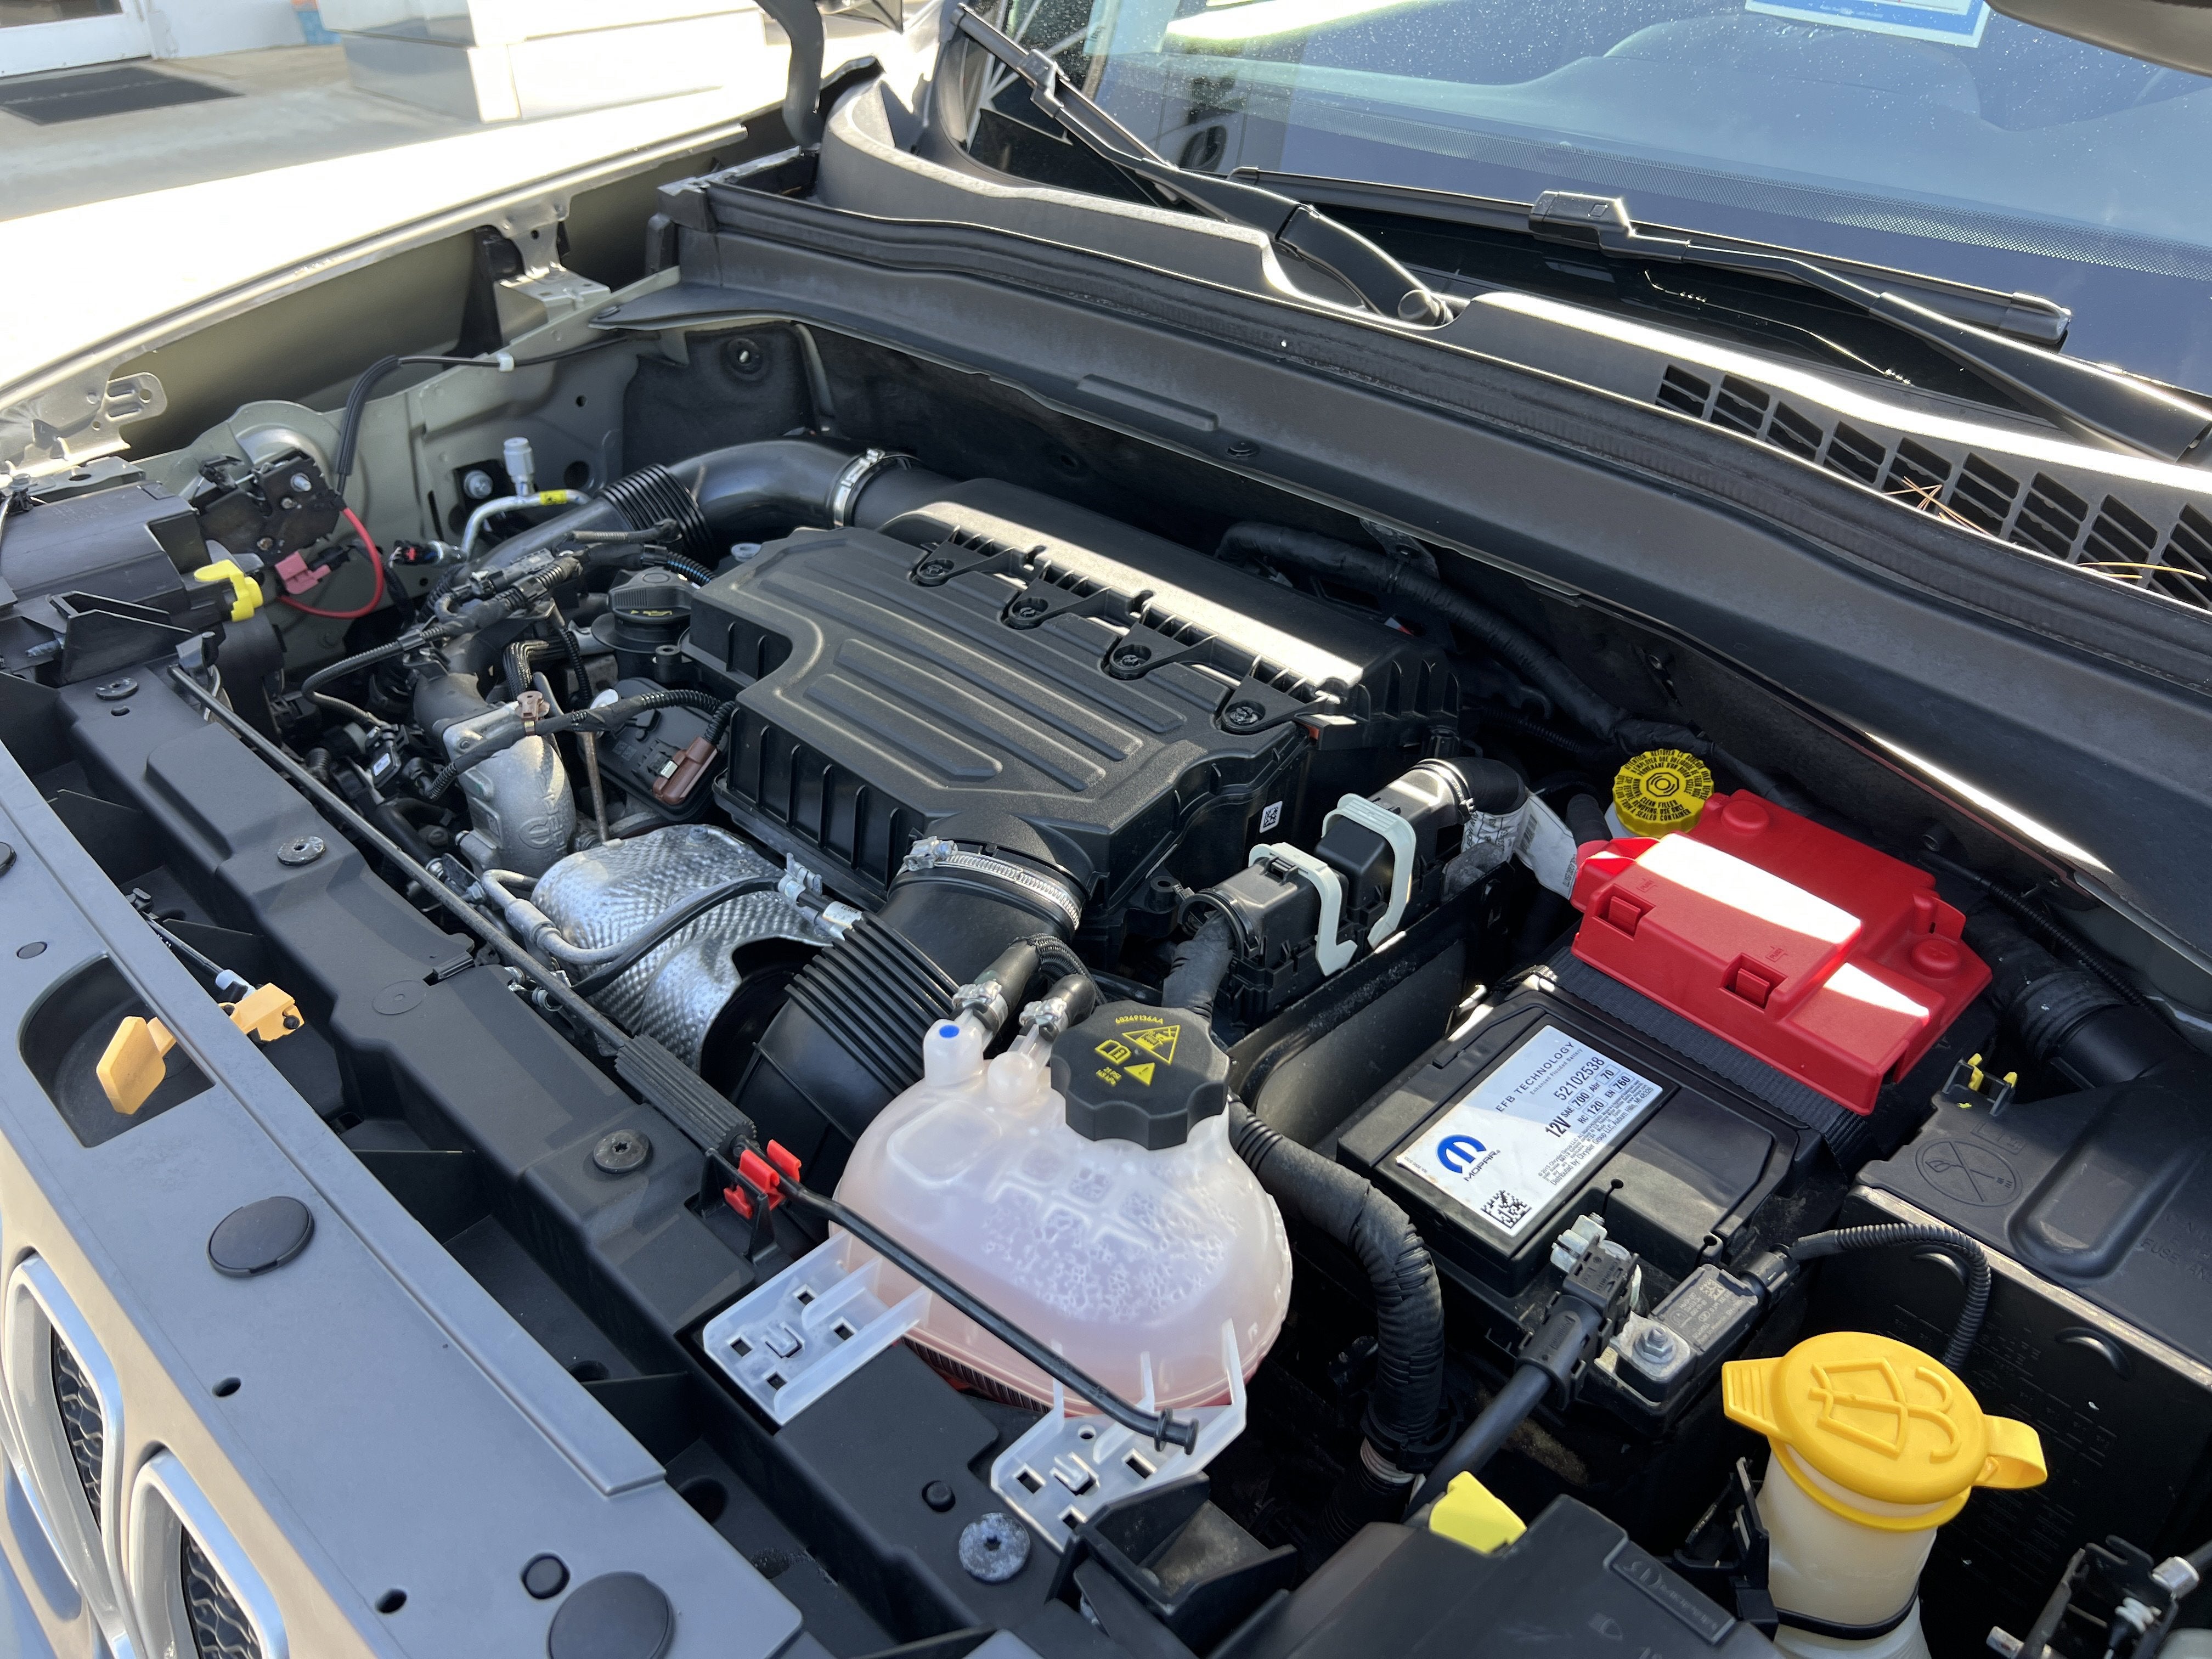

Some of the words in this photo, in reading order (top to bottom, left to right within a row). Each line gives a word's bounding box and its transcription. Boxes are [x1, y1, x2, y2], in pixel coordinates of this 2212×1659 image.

[1636, 811, 1657, 821] SEALED
[1660, 809, 1691, 821] CONTAINER
[1640, 797, 1656, 807] CLEAN
[1658, 799, 1678, 808] FILLER
[1495, 1094, 1517, 1113] EFB
[1513, 1041, 1576, 1096] TECHNOLOGY
[1529, 1075, 1552, 1096] Enhanced
[1549, 1060, 1568, 1077] Flooded
[1565, 1047, 1584, 1062] Battery
[1551, 1055, 1606, 1101] 52102538
[1542, 1115, 1573, 1139] 12V
[1560, 1105, 1575, 1118] SAE
[1570, 1091, 1592, 1108] 700
[1587, 1081, 1602, 1092] Ahr
[1599, 1068, 1616, 1080] 70
[1575, 1142, 1596, 1160] Chrysler
[1590, 1131, 1609, 1146] Group
[1610, 1110, 1628, 1126] Auburn
[1638, 1085, 1655, 1099] 48326
[1577, 1114, 1590, 1124] RC
[1585, 1099, 1605, 1115] 120
[1604, 1089, 1616, 1098] EN
[1611, 1075, 1632, 1091] 760
[1548, 1152, 1564, 1166] Chrysler
[1560, 1143, 1573, 1154] Group
